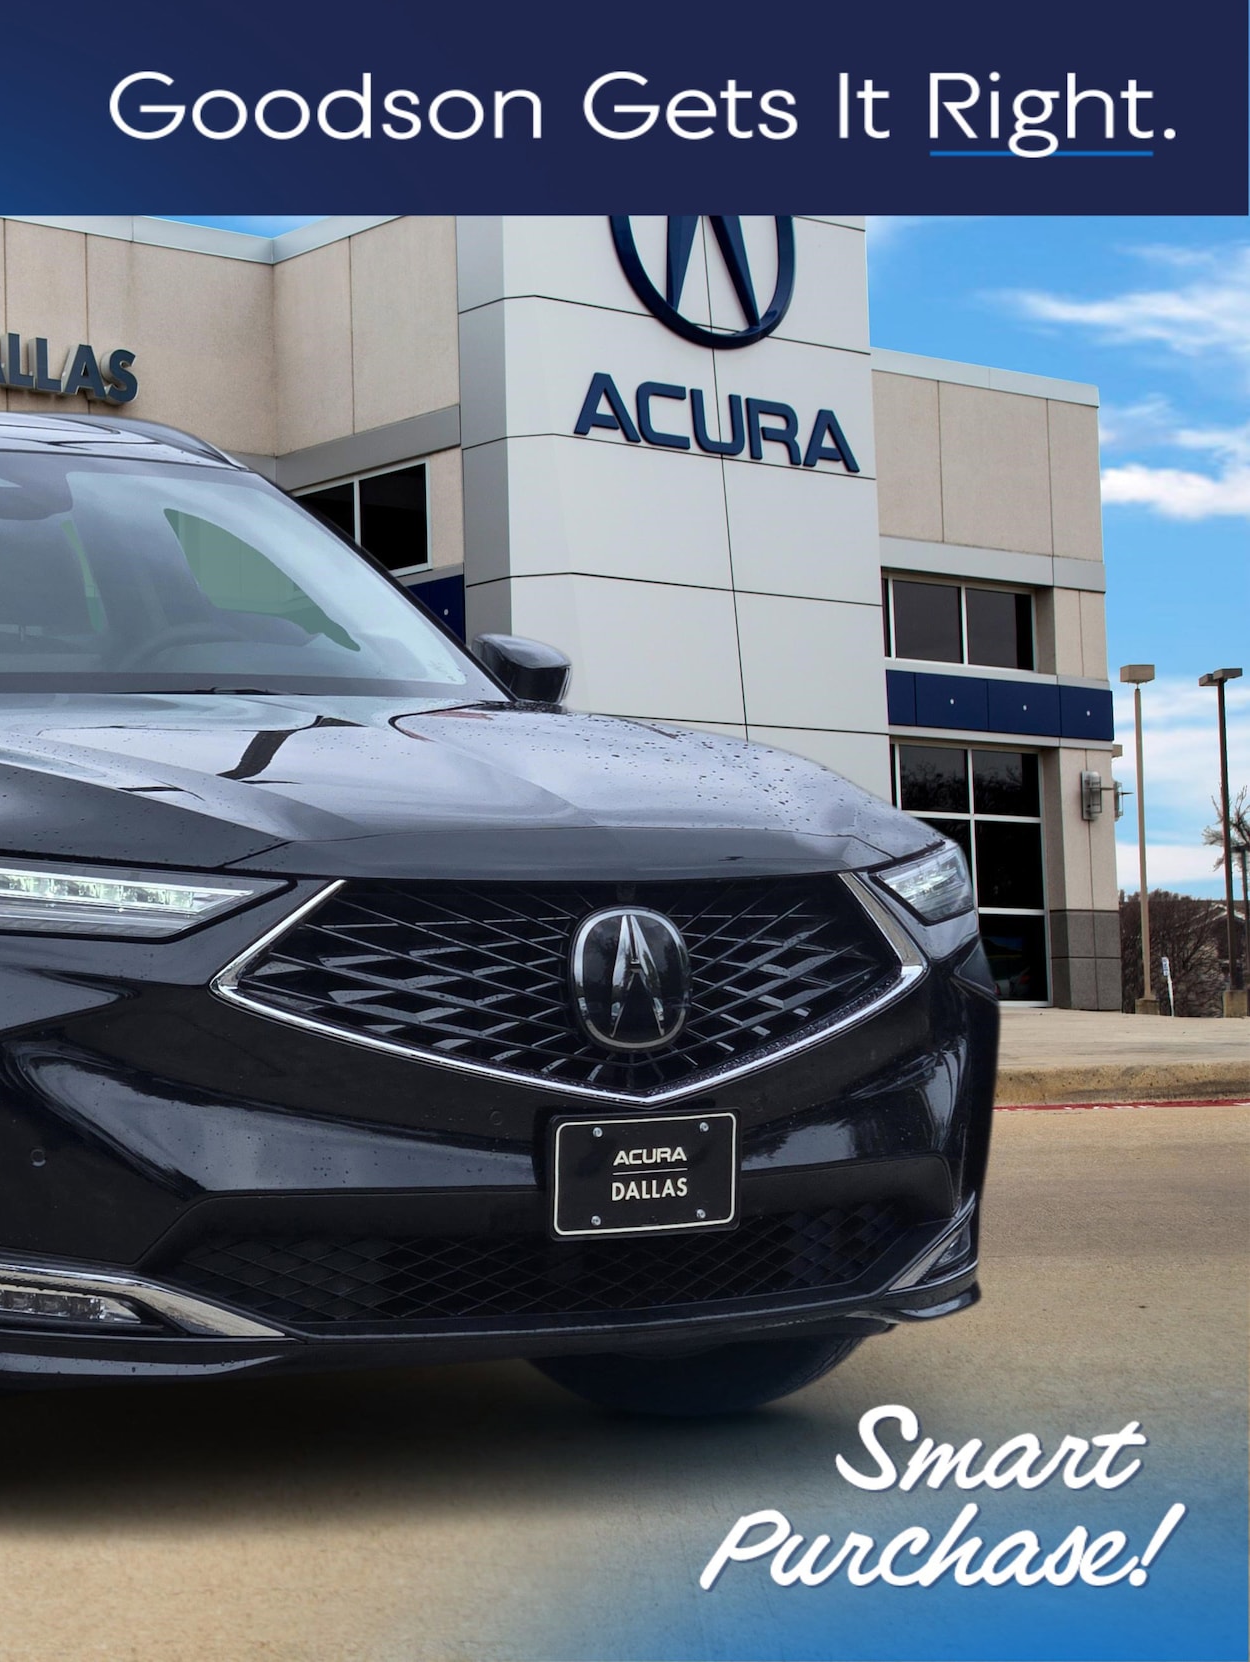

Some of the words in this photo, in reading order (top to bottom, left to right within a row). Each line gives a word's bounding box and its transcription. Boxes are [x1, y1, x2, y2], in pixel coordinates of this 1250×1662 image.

[573, 371, 860, 473] ACURA
[612, 1146, 688, 1166] ACURA
[611, 1176, 689, 1202] DALLAS
